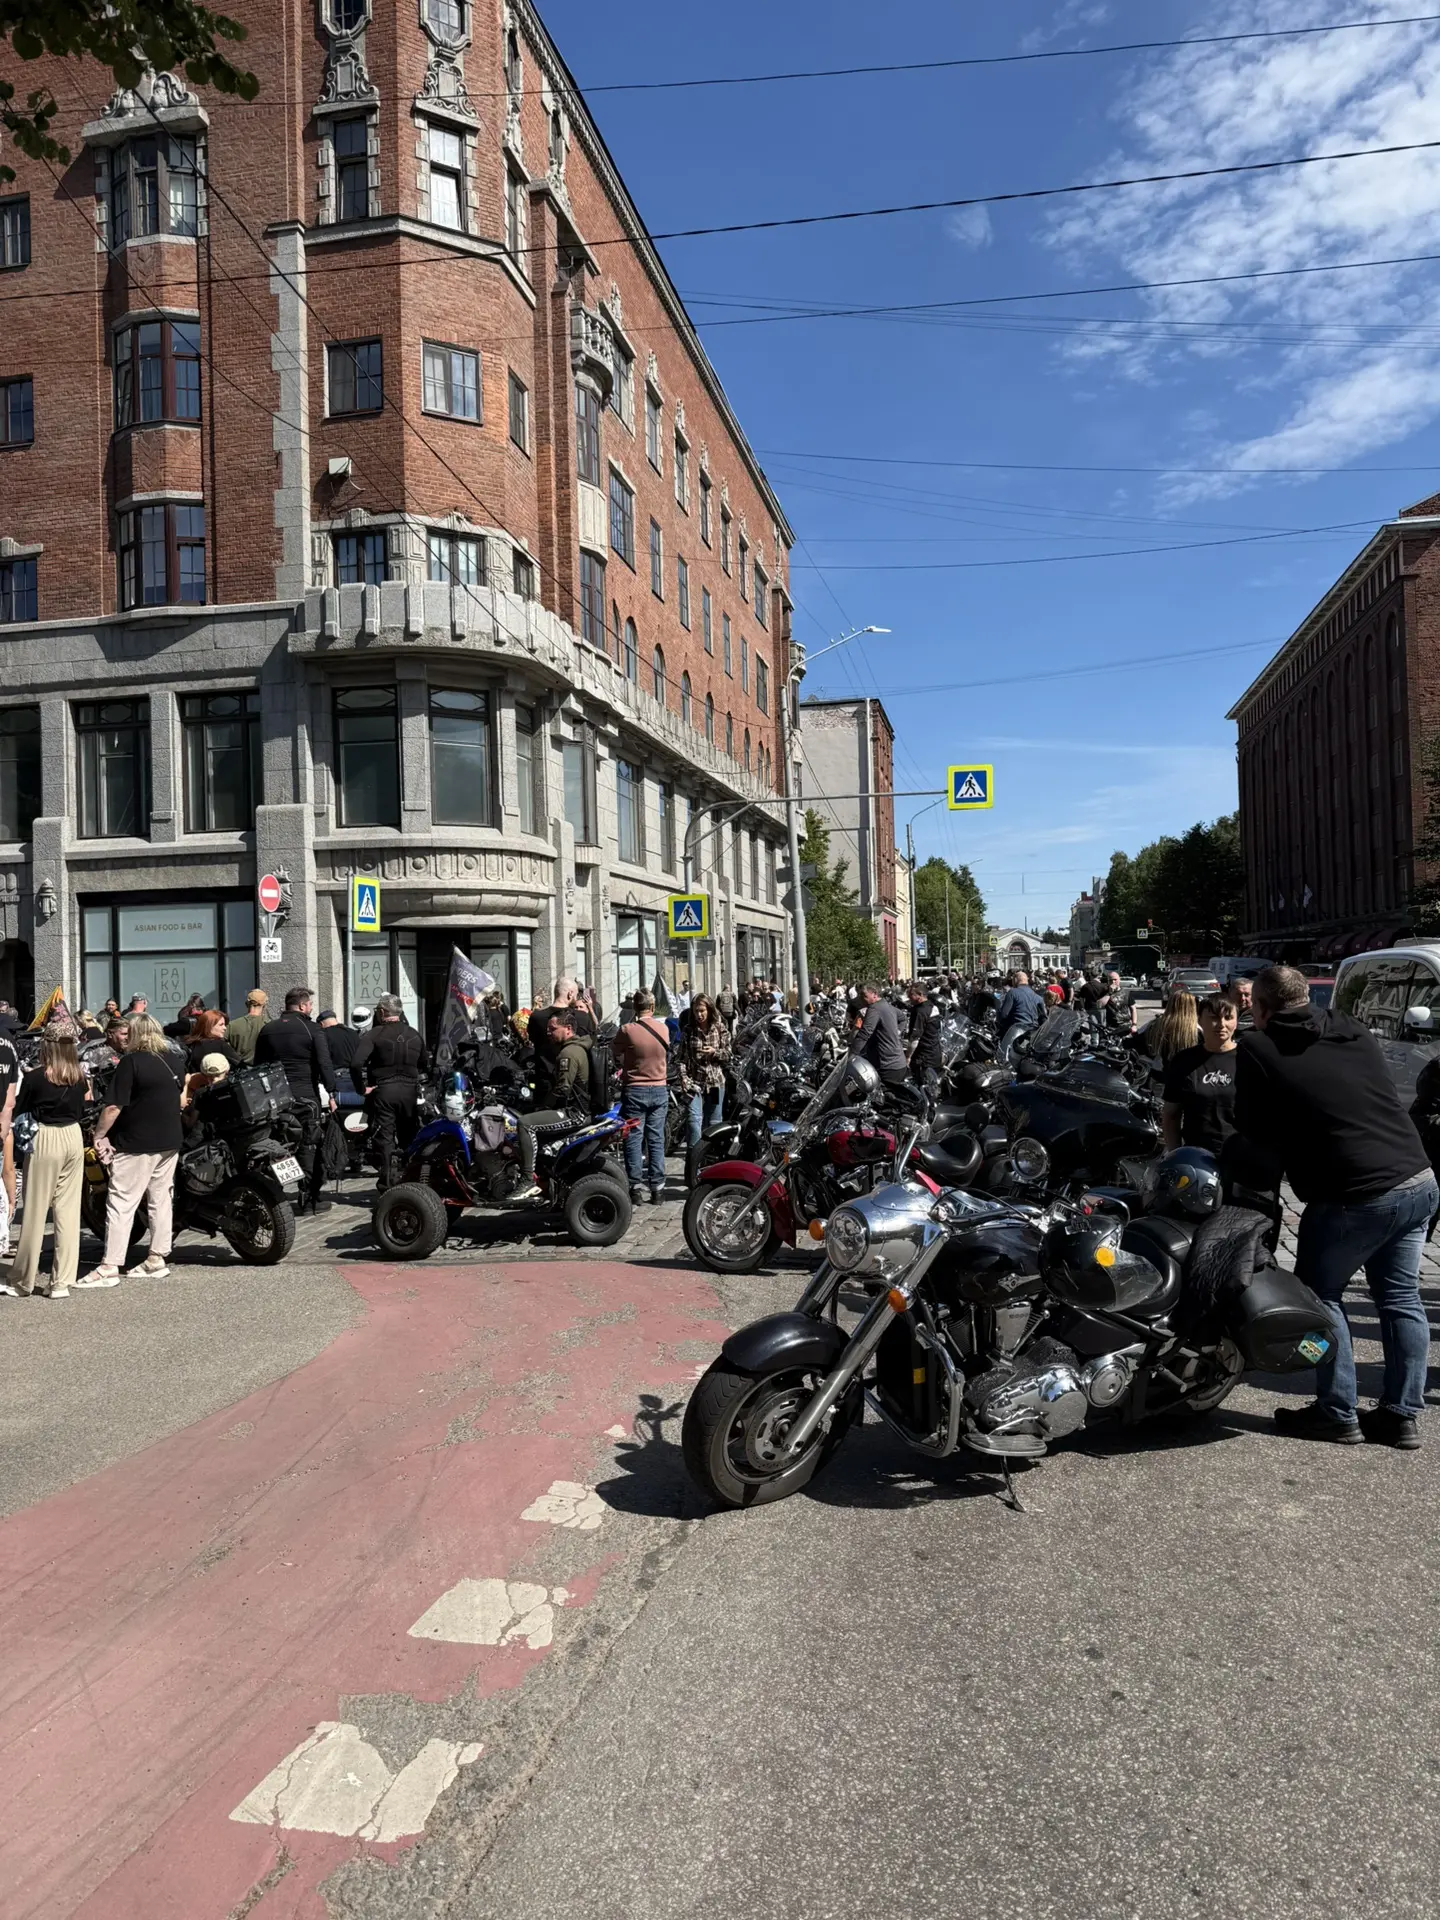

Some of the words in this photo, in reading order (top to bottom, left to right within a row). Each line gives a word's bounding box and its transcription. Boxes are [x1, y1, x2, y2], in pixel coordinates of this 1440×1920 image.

[134, 924, 157, 932] ASIAN
[158, 923, 179, 931] FOOD
[187, 922, 203, 930] BAR
